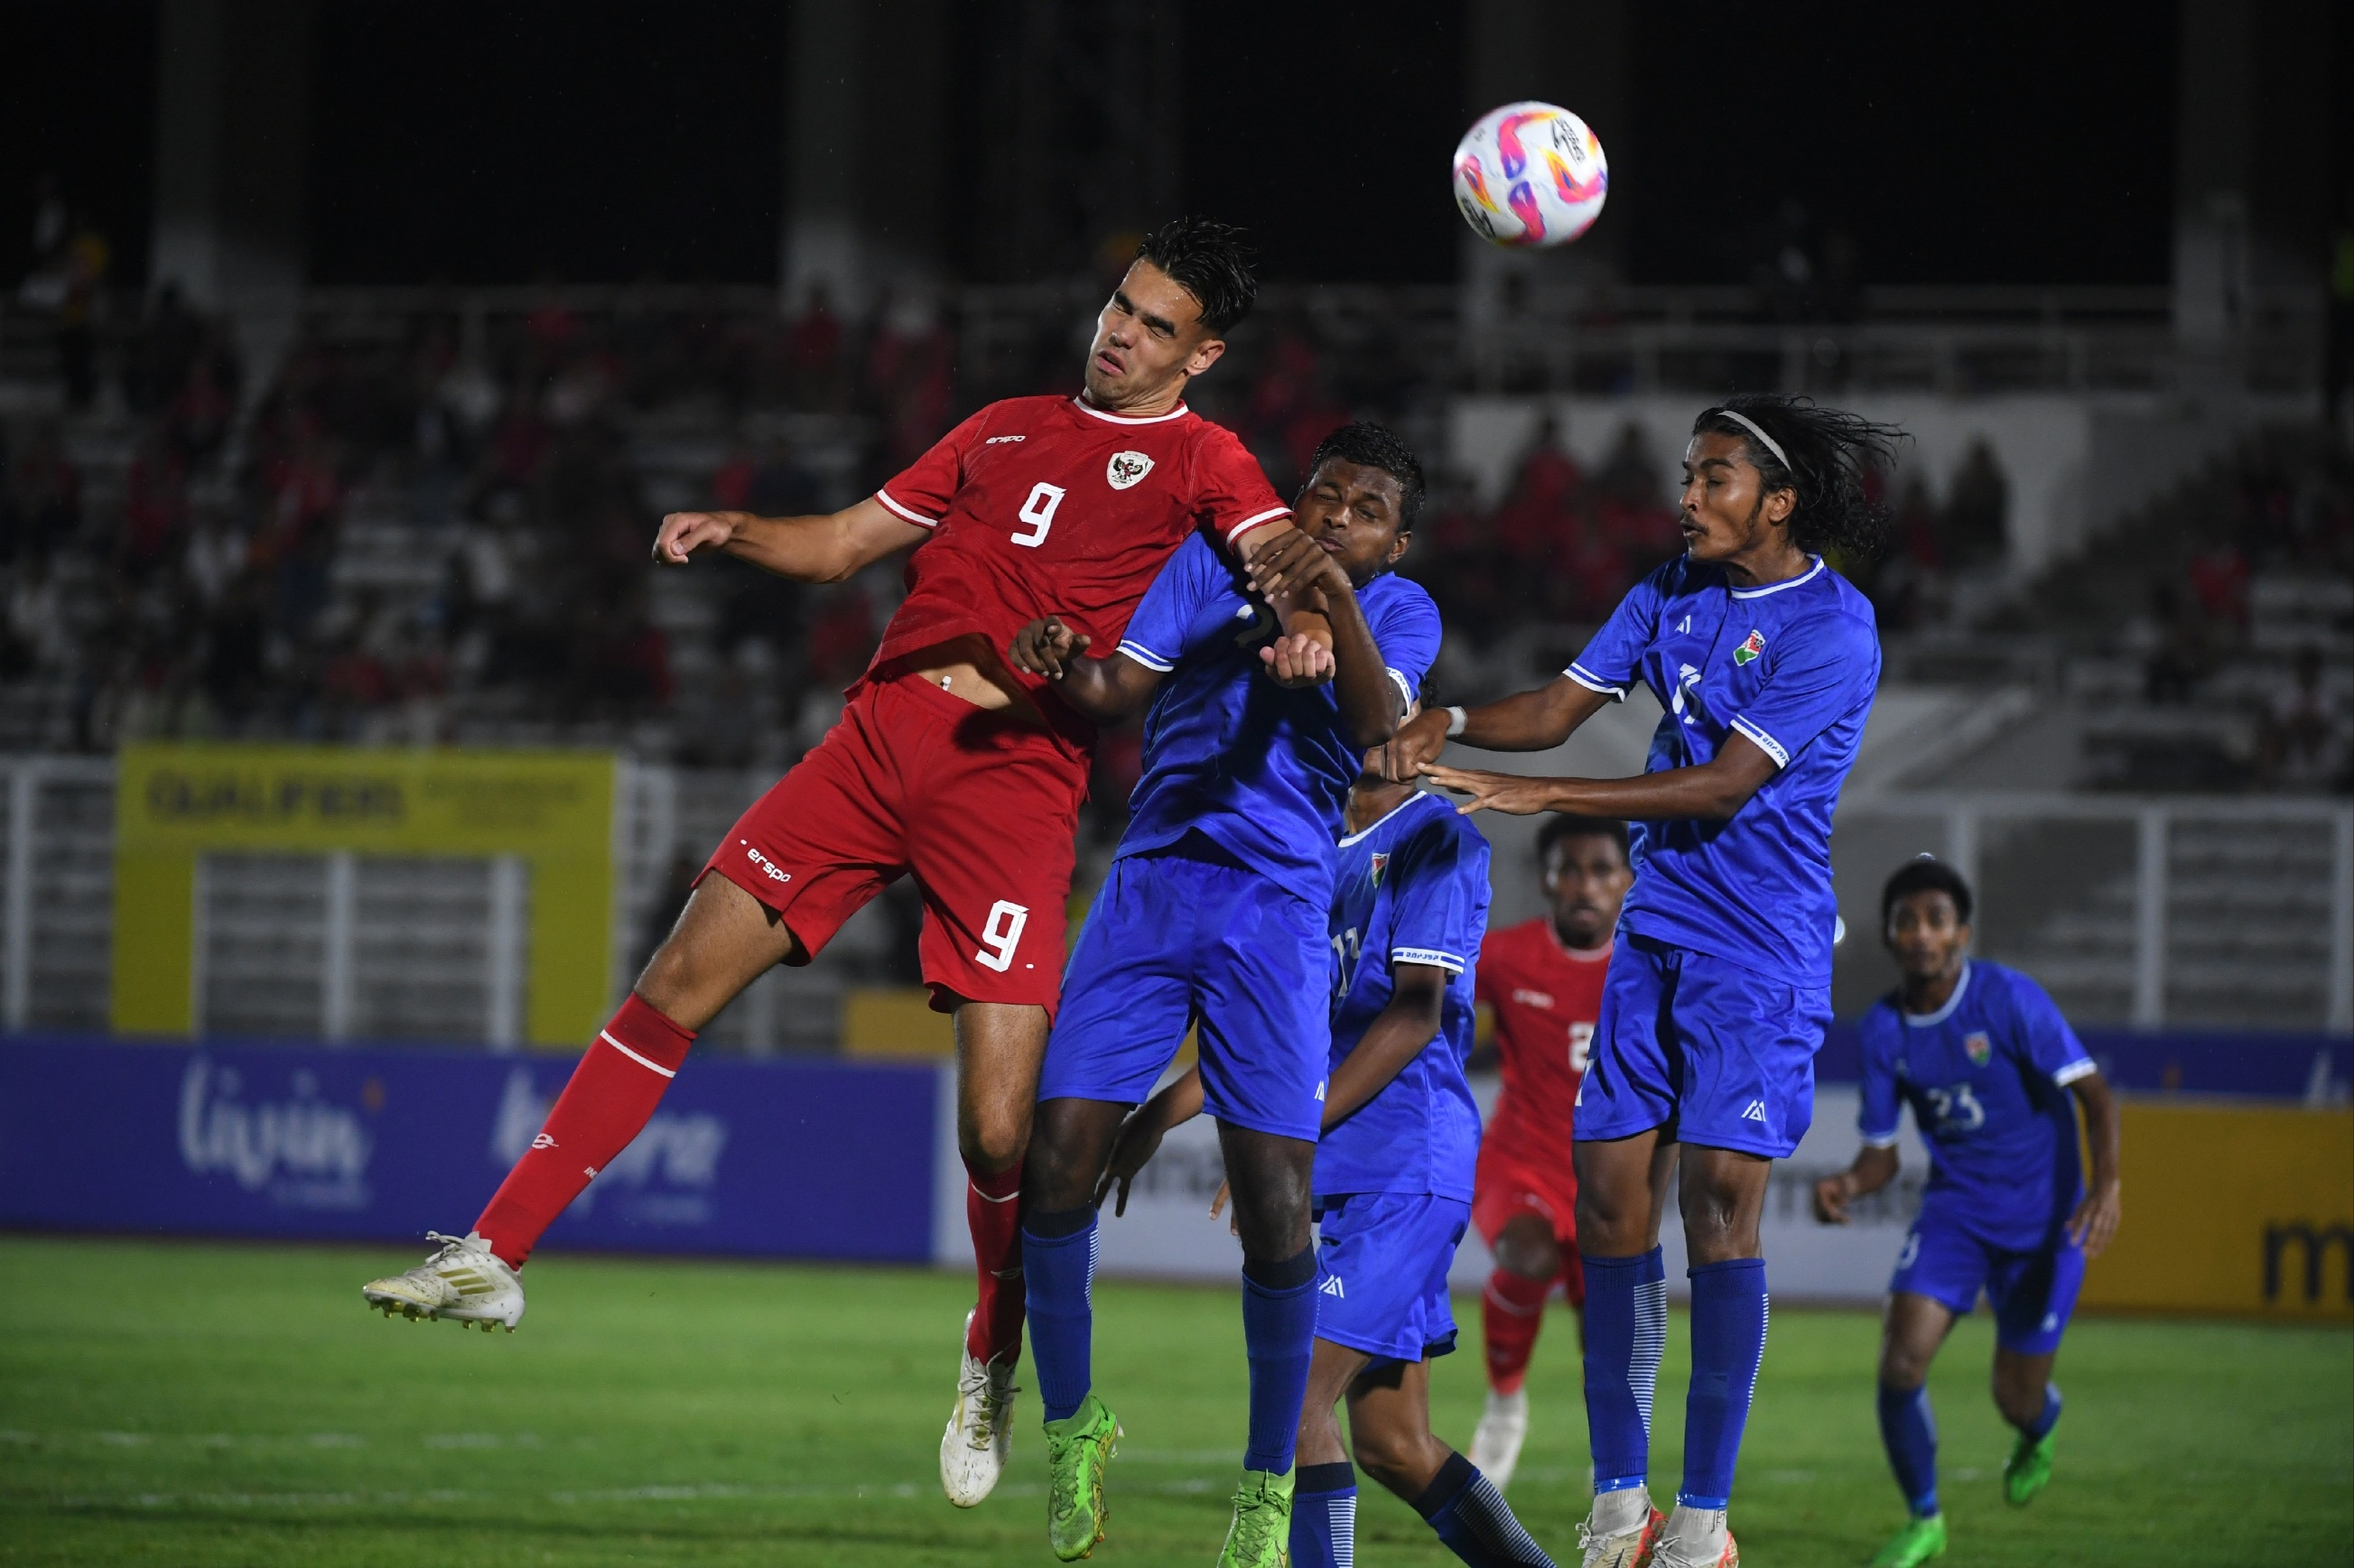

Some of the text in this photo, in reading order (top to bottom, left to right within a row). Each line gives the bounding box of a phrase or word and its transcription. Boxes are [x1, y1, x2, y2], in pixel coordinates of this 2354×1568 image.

[1010, 482, 1067, 548] 9
[747, 846, 792, 884] erspo
[974, 899, 1030, 973] 9
